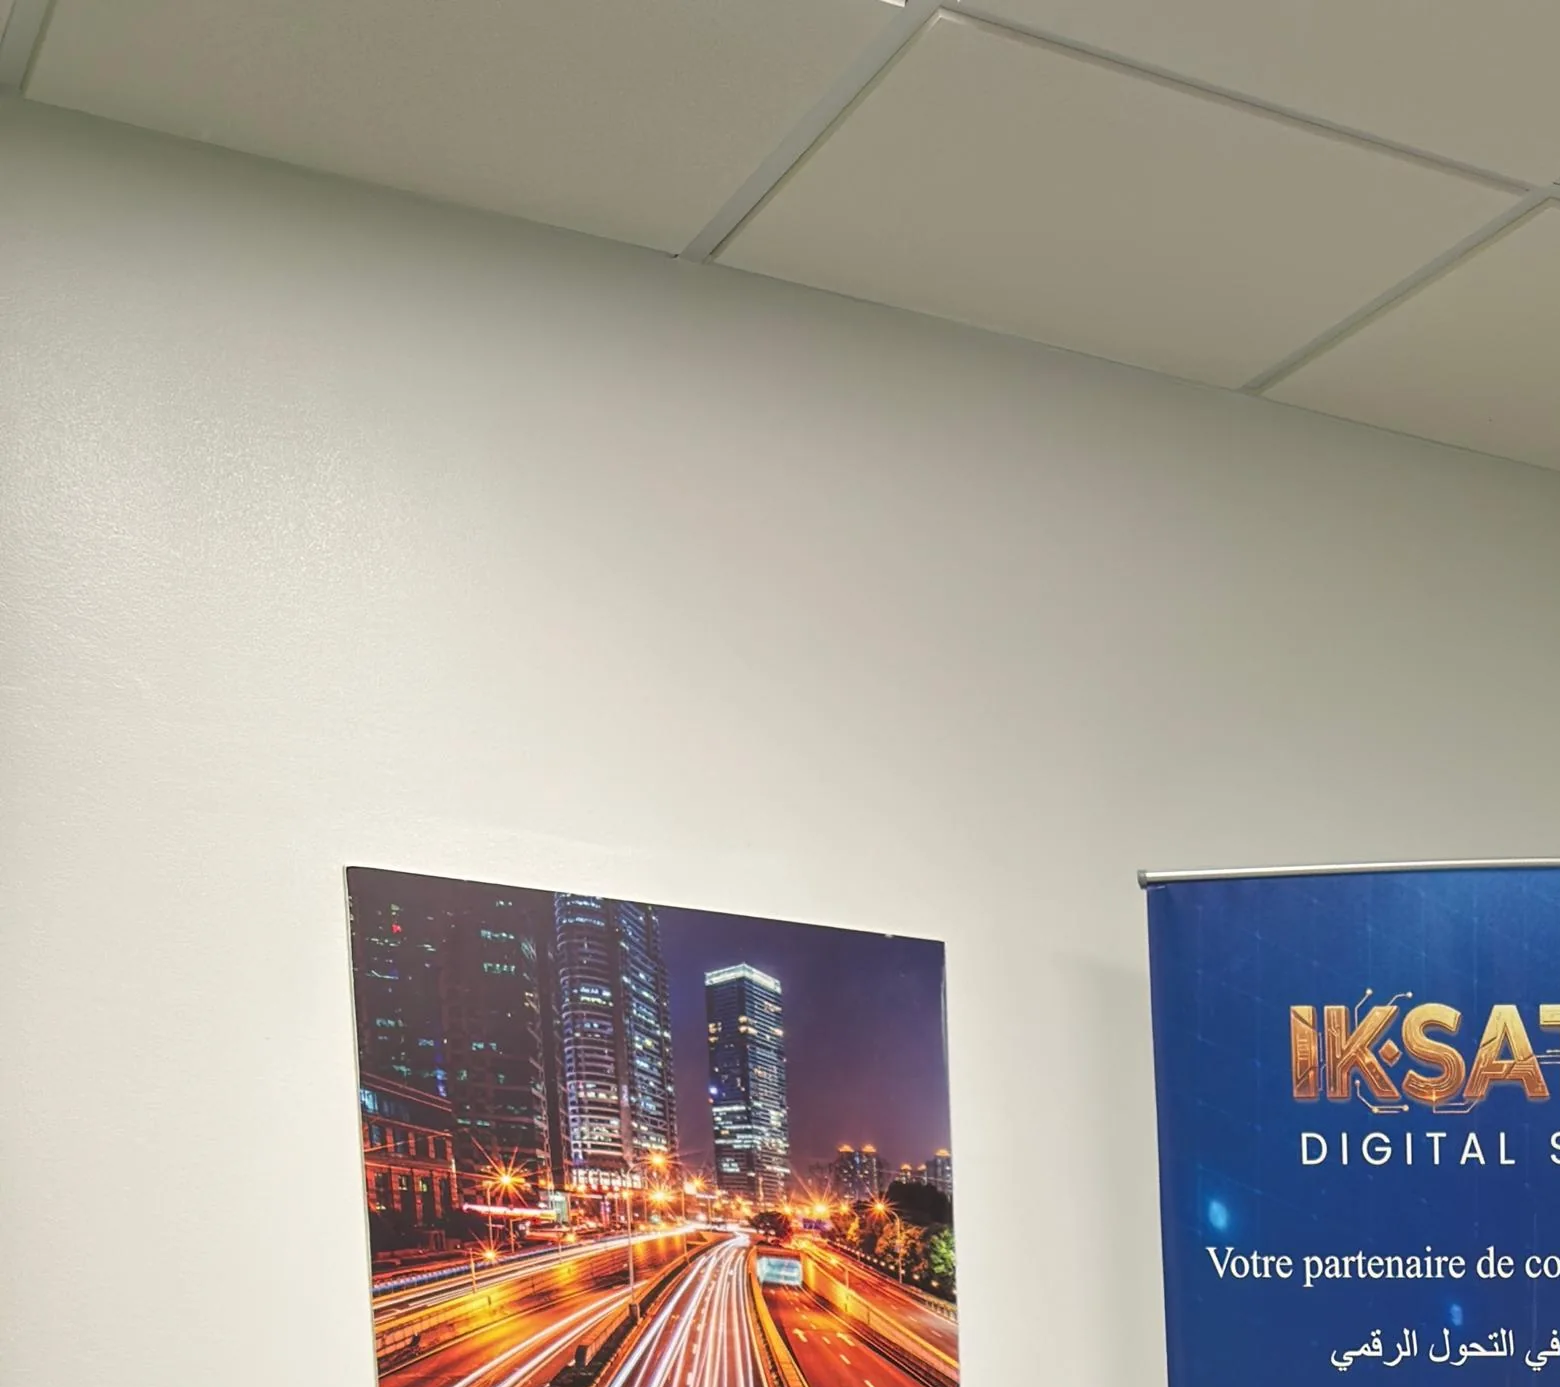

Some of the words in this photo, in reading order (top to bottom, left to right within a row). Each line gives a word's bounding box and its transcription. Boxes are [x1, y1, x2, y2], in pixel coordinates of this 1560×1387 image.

[1301, 1132, 1516, 1166] DIGITAL
[1206, 1247, 1293, 1279] Votre
[1303, 1245, 1466, 1288] partenaire
[1476, 1245, 1514, 1279] de
[1330, 1327, 1418, 1372] الرقمي
[1429, 1327, 1514, 1366] التحول
[1525, 1329, 1560, 1372] في
